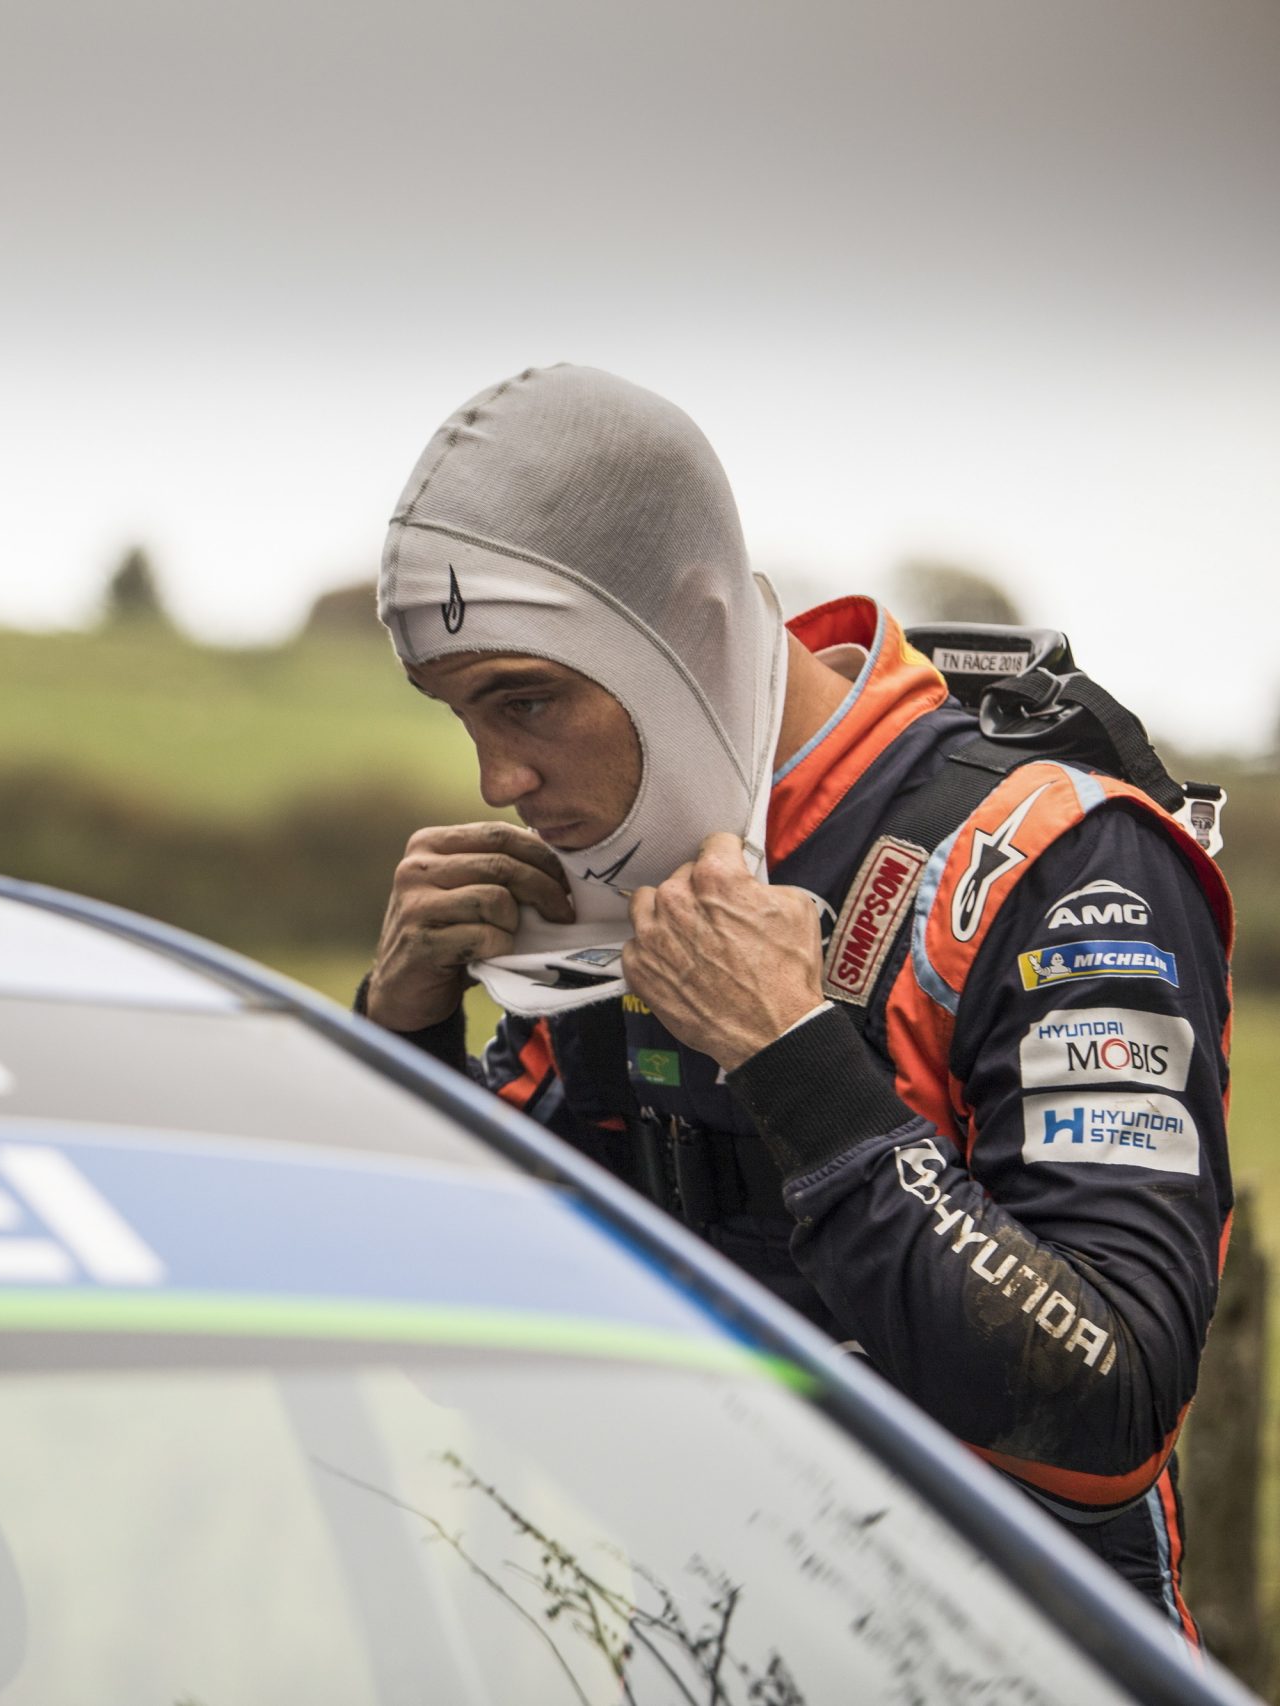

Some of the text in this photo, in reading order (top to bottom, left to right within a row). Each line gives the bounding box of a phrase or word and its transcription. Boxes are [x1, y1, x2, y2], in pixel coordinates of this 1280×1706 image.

[942, 652, 959, 669] TN
[962, 654, 997, 671] RACE
[838, 857, 910, 985] SIMPSON
[1048, 903, 1148, 929] AMG
[1073, 952, 1168, 972] MICHELIN
[1039, 1021, 1124, 1039] HYUNDAI
[1065, 1038, 1169, 1075] MOBIS
[1091, 1109, 1183, 1134] HYUNDAI
[1091, 1128, 1157, 1150] STEEL
[934, 1194, 1117, 1376] HYUNDAI
